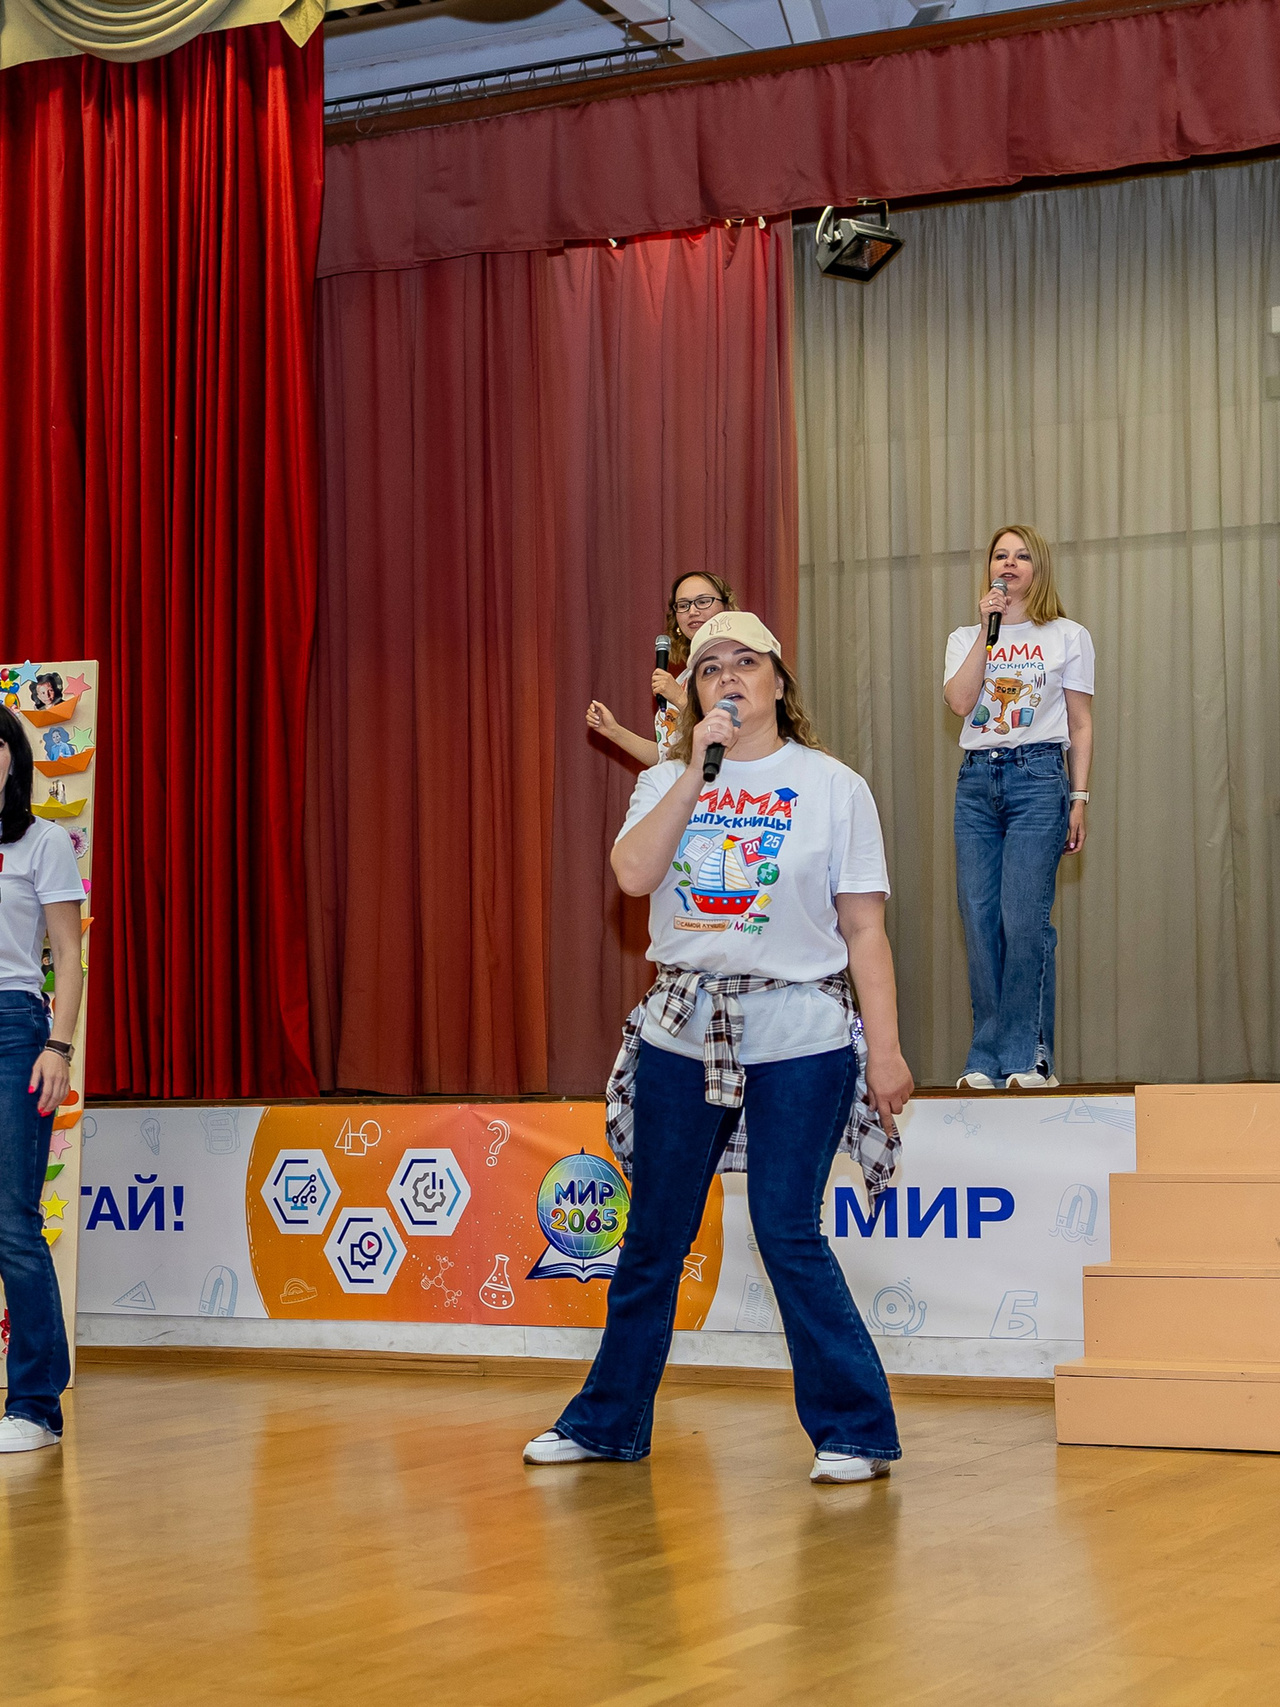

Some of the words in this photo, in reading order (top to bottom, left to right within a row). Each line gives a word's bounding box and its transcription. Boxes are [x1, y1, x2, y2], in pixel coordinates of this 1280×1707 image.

[996, 686, 1017, 695] 2025
[745, 840, 760, 856] 20
[763, 834, 780, 849] 25
[734, 920, 764, 935] МИРЕ
[554, 1180, 615, 1206] МИР
[551, 1207, 619, 1234] 2065
[834, 1186, 1016, 1239] МИР
